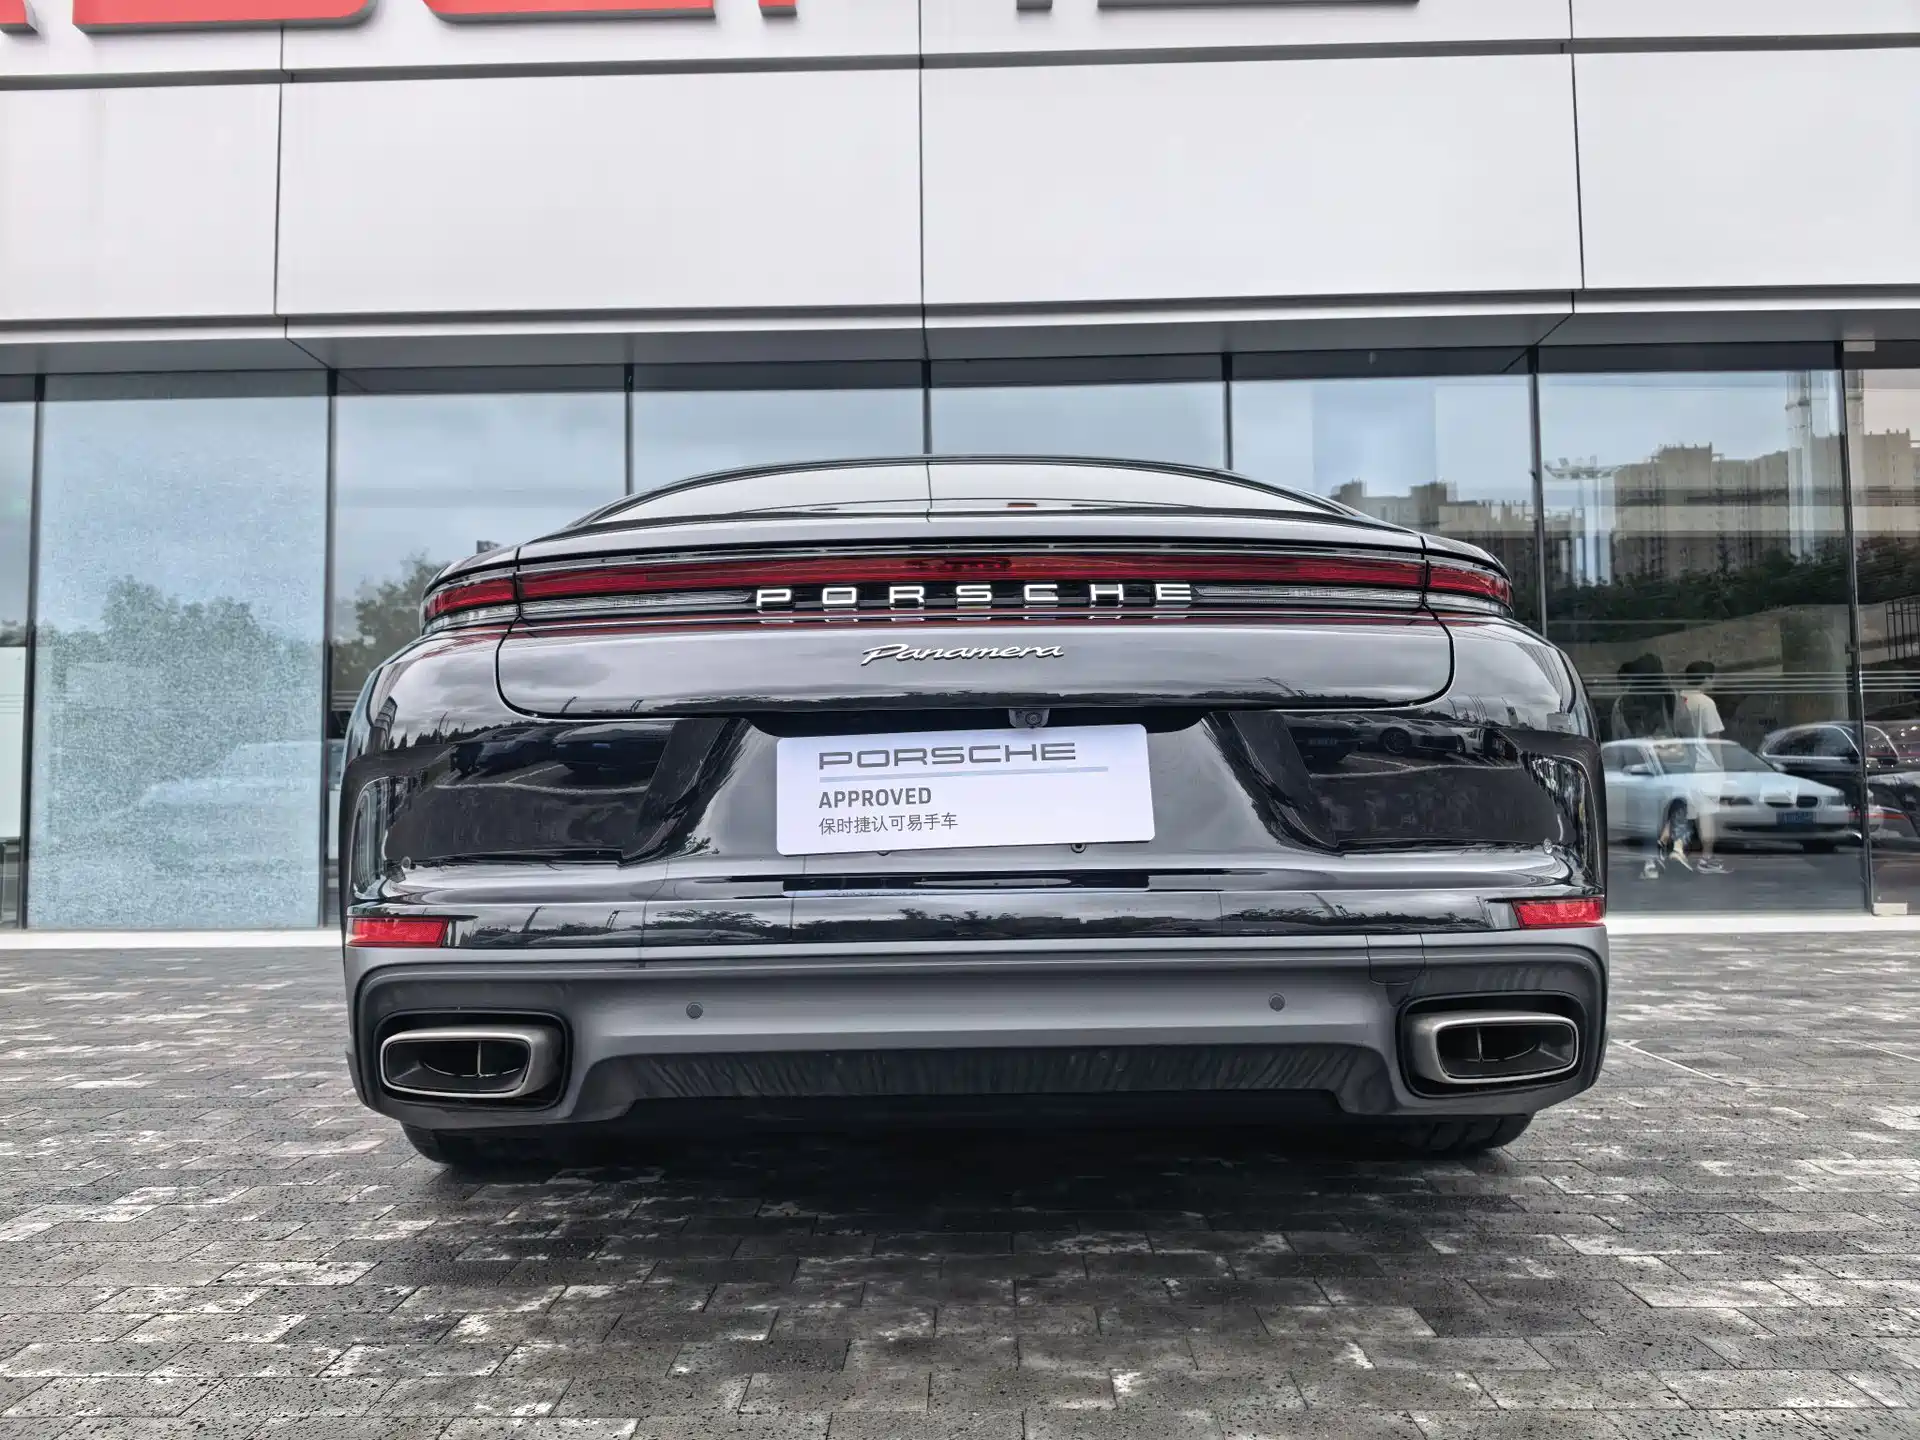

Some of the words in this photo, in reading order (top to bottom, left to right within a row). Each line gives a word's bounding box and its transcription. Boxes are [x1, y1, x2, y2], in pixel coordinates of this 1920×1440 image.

[756, 583, 1192, 607] PORSCHE
[861, 643, 1064, 666] Panamera
[818, 742, 1076, 770] PORSCHE
[818, 787, 932, 809] APPROVED
[818, 812, 958, 836] 保时捷认可易手车
